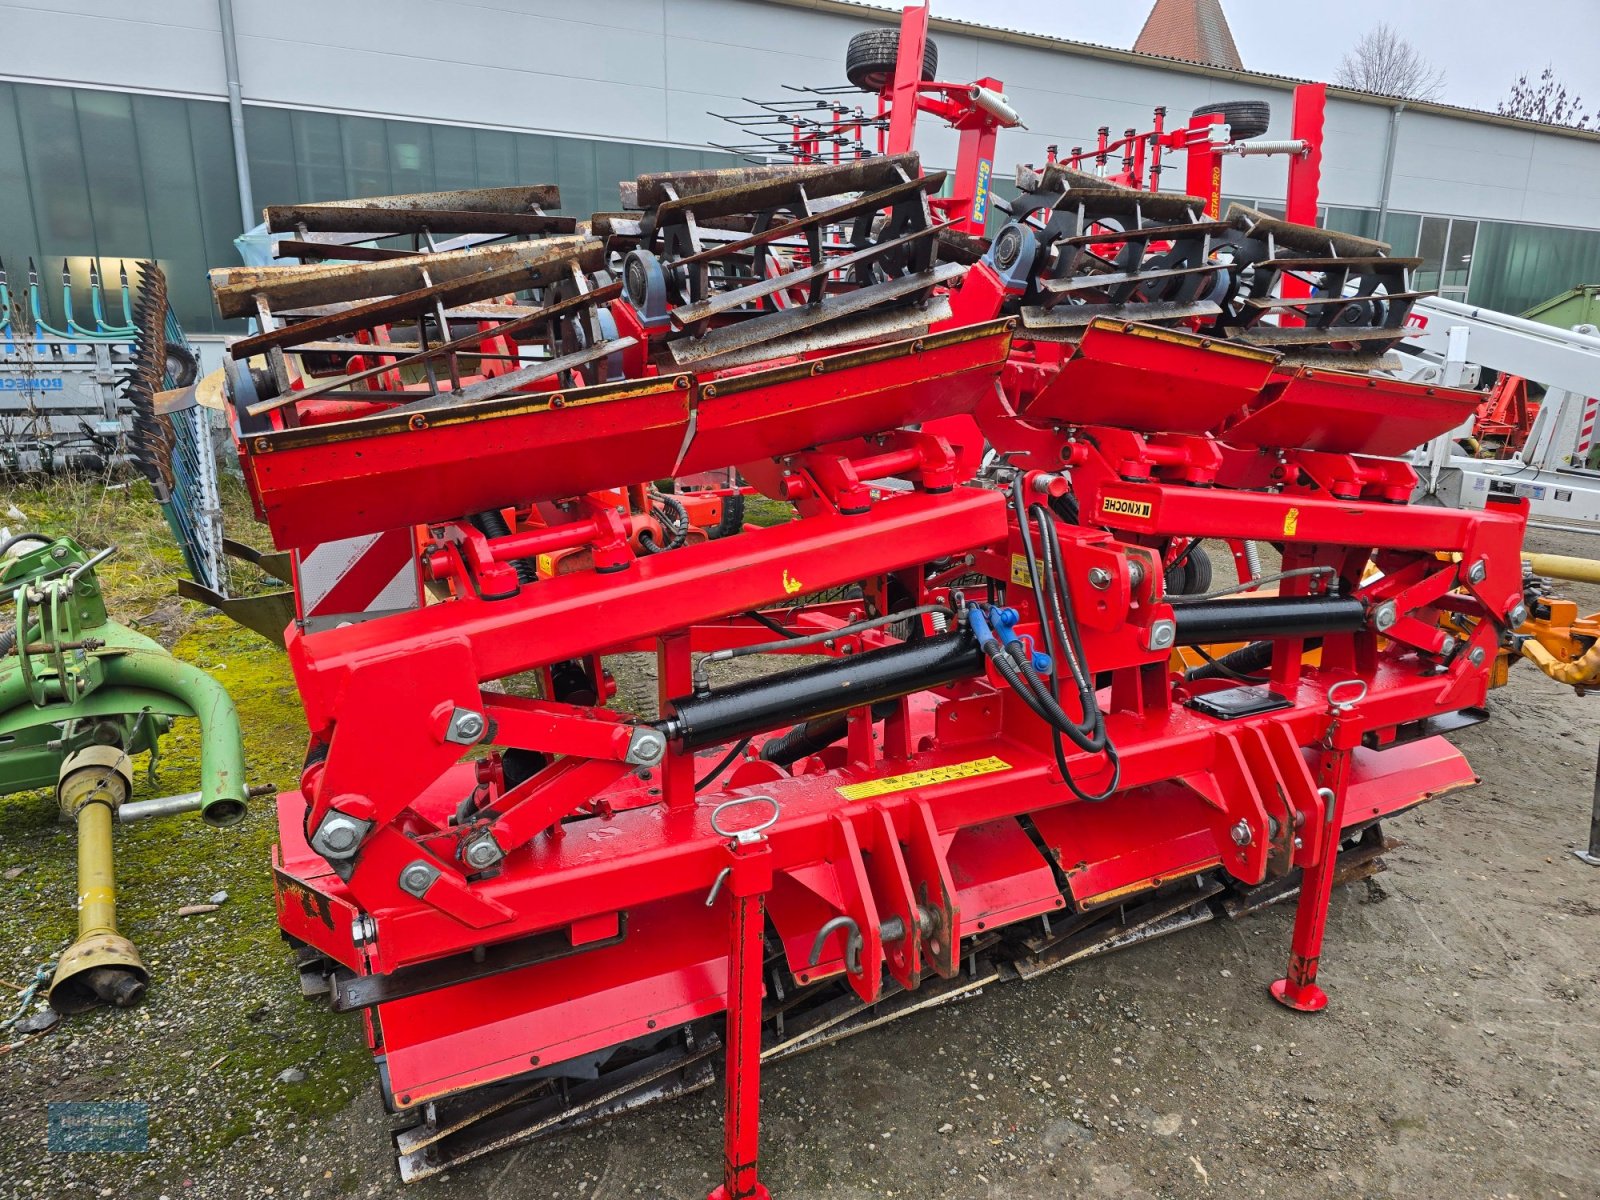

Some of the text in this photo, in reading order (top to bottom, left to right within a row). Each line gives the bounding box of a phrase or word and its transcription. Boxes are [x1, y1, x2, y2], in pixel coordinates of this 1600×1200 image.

[974, 161, 990, 221] Einböck
[0, 378, 63, 389] BOMEC
[1104, 499, 1142, 515] KNOCHE
